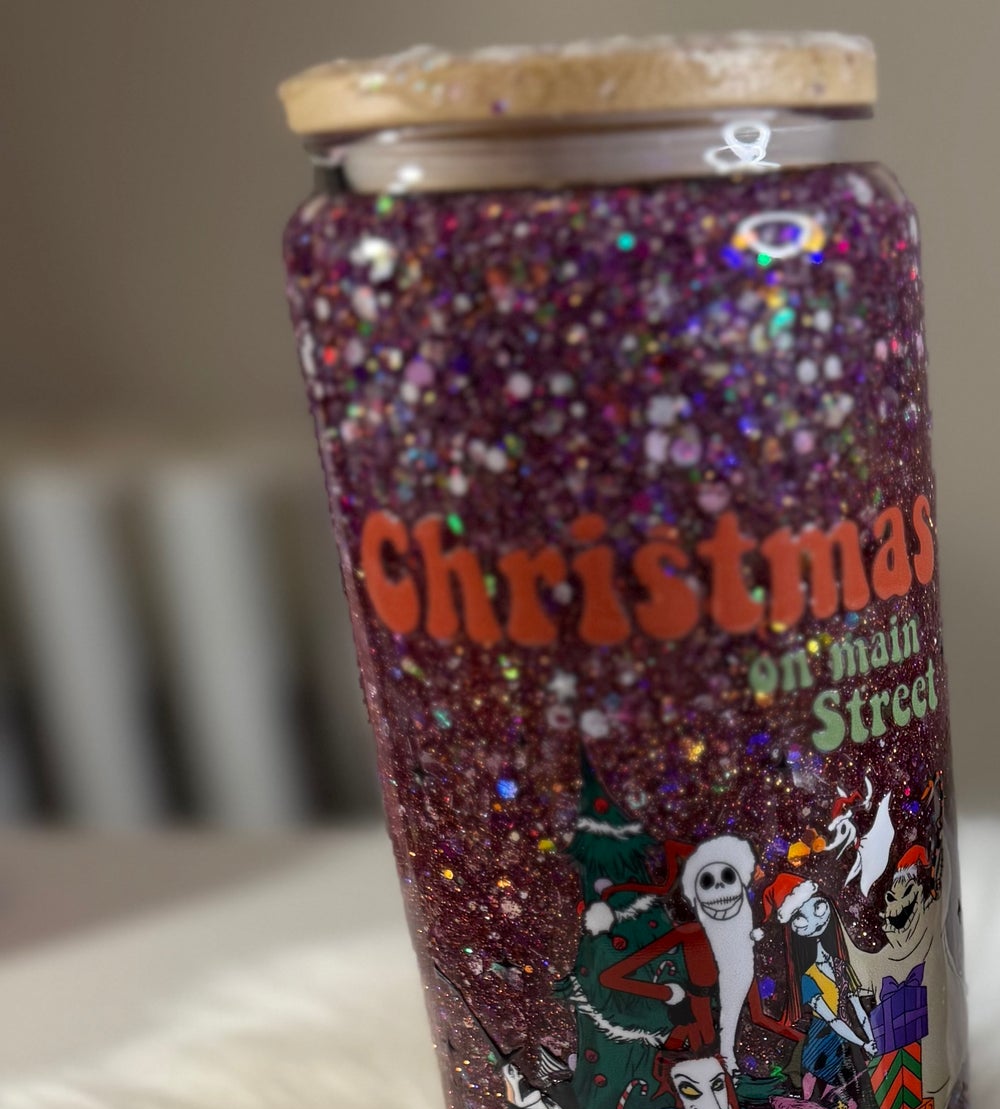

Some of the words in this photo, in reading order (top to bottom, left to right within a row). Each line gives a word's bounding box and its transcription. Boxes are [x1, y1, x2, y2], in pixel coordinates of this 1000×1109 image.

[360, 495, 936, 646] Christmas
[749, 650, 814, 692] on
[829, 615, 920, 682] main
[811, 658, 938, 752] Street
